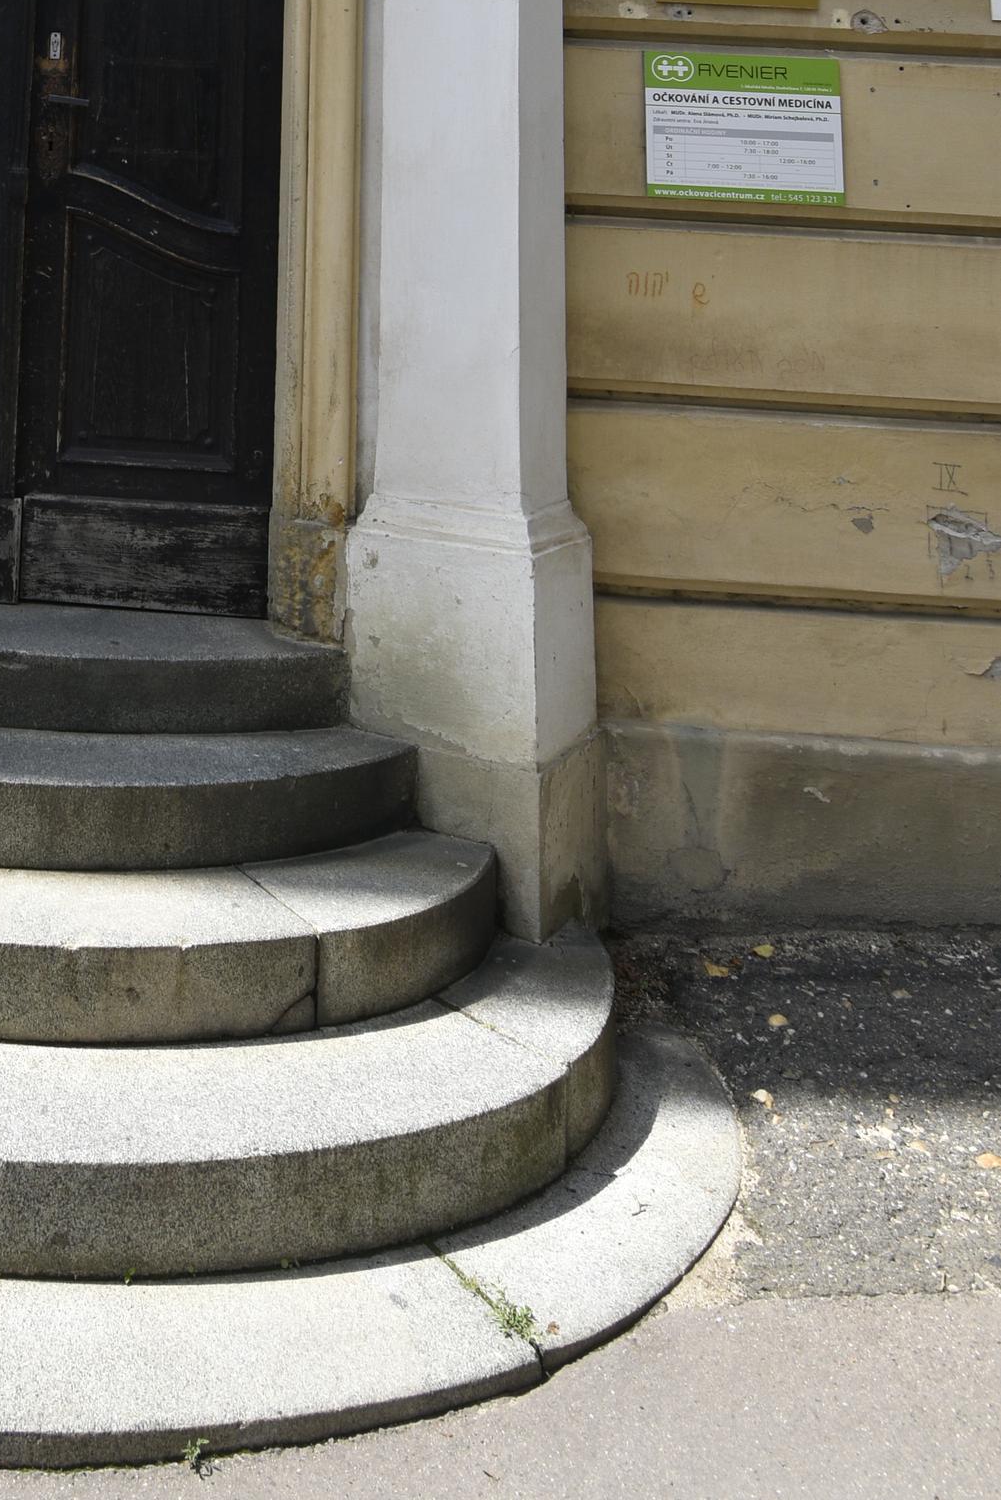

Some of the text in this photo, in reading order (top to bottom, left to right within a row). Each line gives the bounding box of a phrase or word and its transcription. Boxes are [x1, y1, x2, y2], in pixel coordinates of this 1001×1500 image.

[698, 63, 788, 80] AVENIER
[652, 91, 832, 110] OČKOVÁNÍ A CESTOVNÍ MEDICÍNA
[654, 187, 766, 201] www.ockovacicentrum.cz
[788, 194, 803, 202] 545
[806, 195, 821, 203] 123
[823, 195, 837, 203] 321
